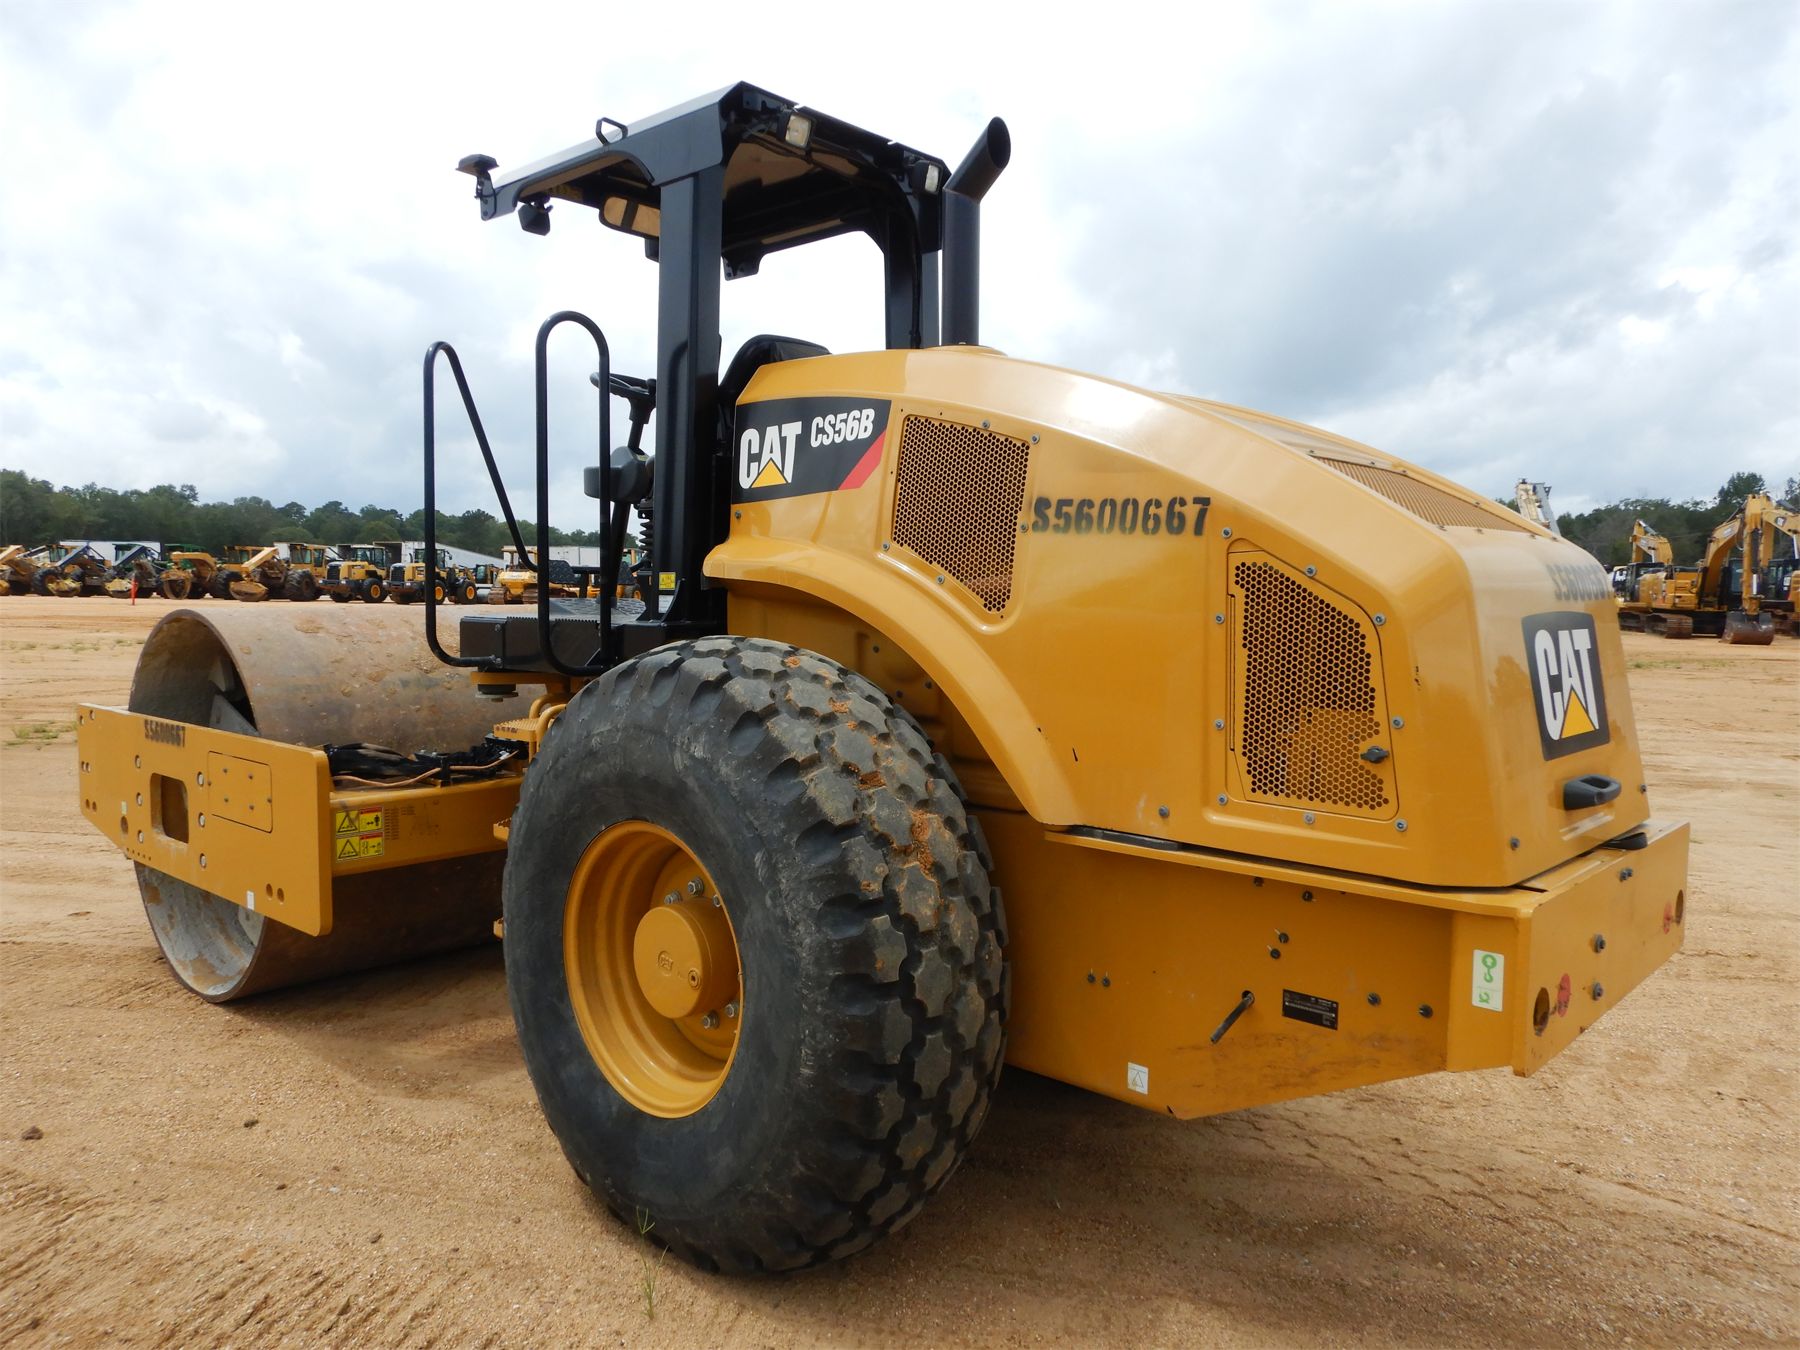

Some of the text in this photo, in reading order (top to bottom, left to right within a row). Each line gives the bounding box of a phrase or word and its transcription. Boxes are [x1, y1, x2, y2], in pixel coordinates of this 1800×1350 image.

[810, 408, 875, 448] CS56B
[738, 421, 802, 490] CAT
[1031, 496, 1211, 536] S5600667
[1534, 628, 1600, 741] CAT
